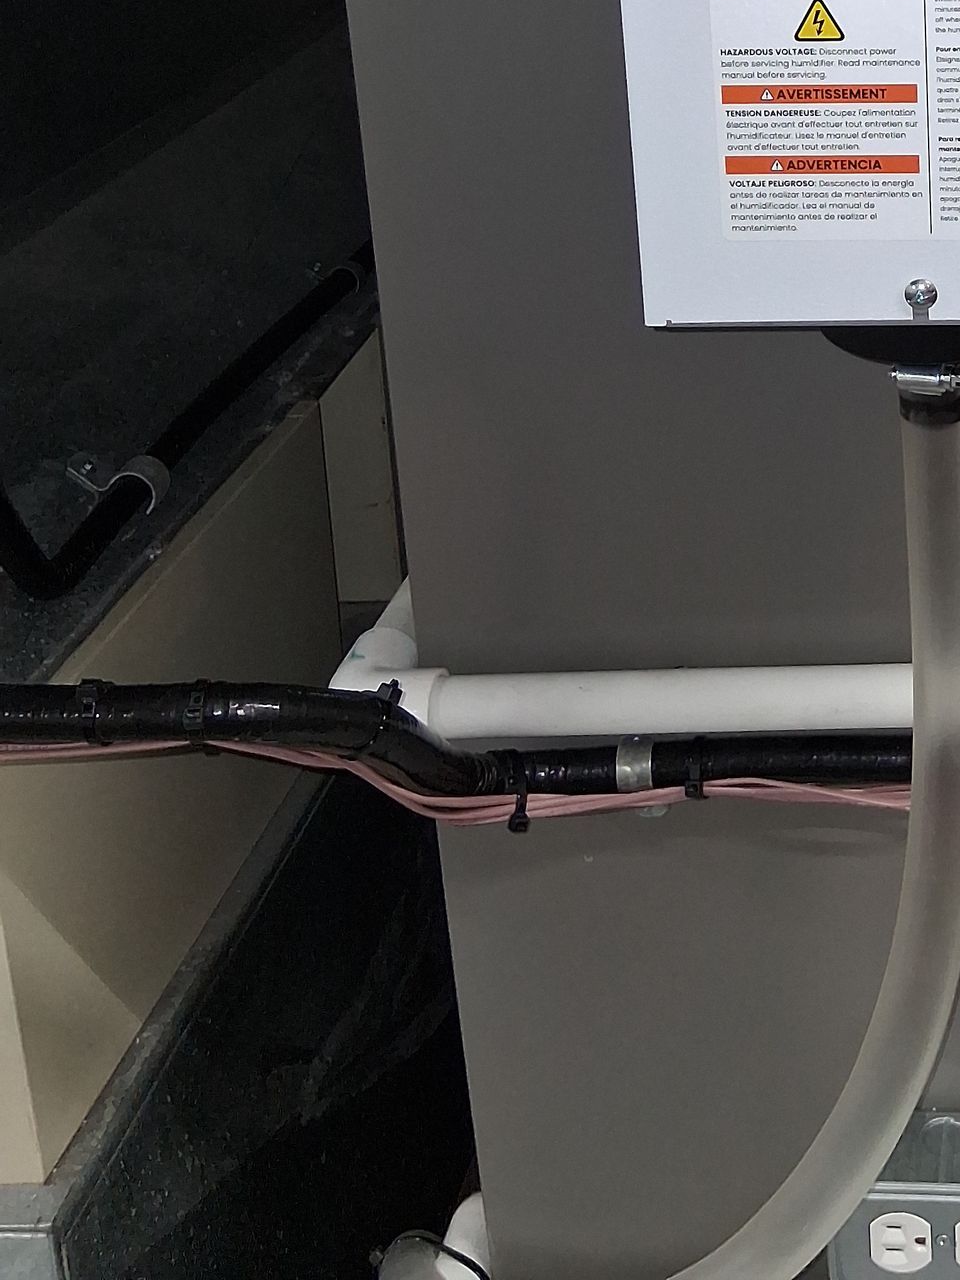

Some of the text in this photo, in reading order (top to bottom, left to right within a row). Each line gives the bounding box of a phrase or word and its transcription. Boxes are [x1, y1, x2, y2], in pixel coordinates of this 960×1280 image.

[720, 47, 896, 58] HAZARDOUS VOLTAGE: Disconnect power
[720, 59, 749, 68] before
[751, 59, 790, 70] servicing
[837, 59, 861, 67] Read
[862, 59, 921, 67] maintenance
[721, 70, 827, 81] manual before servicing.
[776, 88, 888, 101] AVERTISSEMENT
[725, 110, 762, 118] TENSION
[763, 109, 822, 118] DANGEREUSE:
[823, 109, 857, 119] Coupez
[770, 121, 795, 129] avant
[845, 120, 862, 129] tout
[864, 120, 903, 128] entretien
[905, 120, 918, 128] sur
[816, 131, 825, 140] le
[826, 131, 860, 140] manuel
[727, 143, 752, 152] avant
[801, 143, 819, 151] tout
[786, 159, 882, 171] ADVERTENCIA
[729, 180, 767, 188] VOLTAJE
[768, 179, 818, 188] PELIGROSO:
[818, 179, 870, 188] Desconecte
[871, 179, 880, 188] la
[729, 191, 754, 199] antes
[755, 191, 767, 199] de
[768, 190, 800, 199] realizar
[801, 190, 830, 199] tareas
[831, 190, 843, 199] de
[844, 190, 910, 198] mantenimiento
[730, 202, 738, 210] el
[802, 202, 818, 210] Lea
[819, 202, 827, 210] el
[828, 202, 862, 210] manual
[864, 201, 875, 210] de
[731, 212, 878, 221] mantenimiento antes de realizar el
